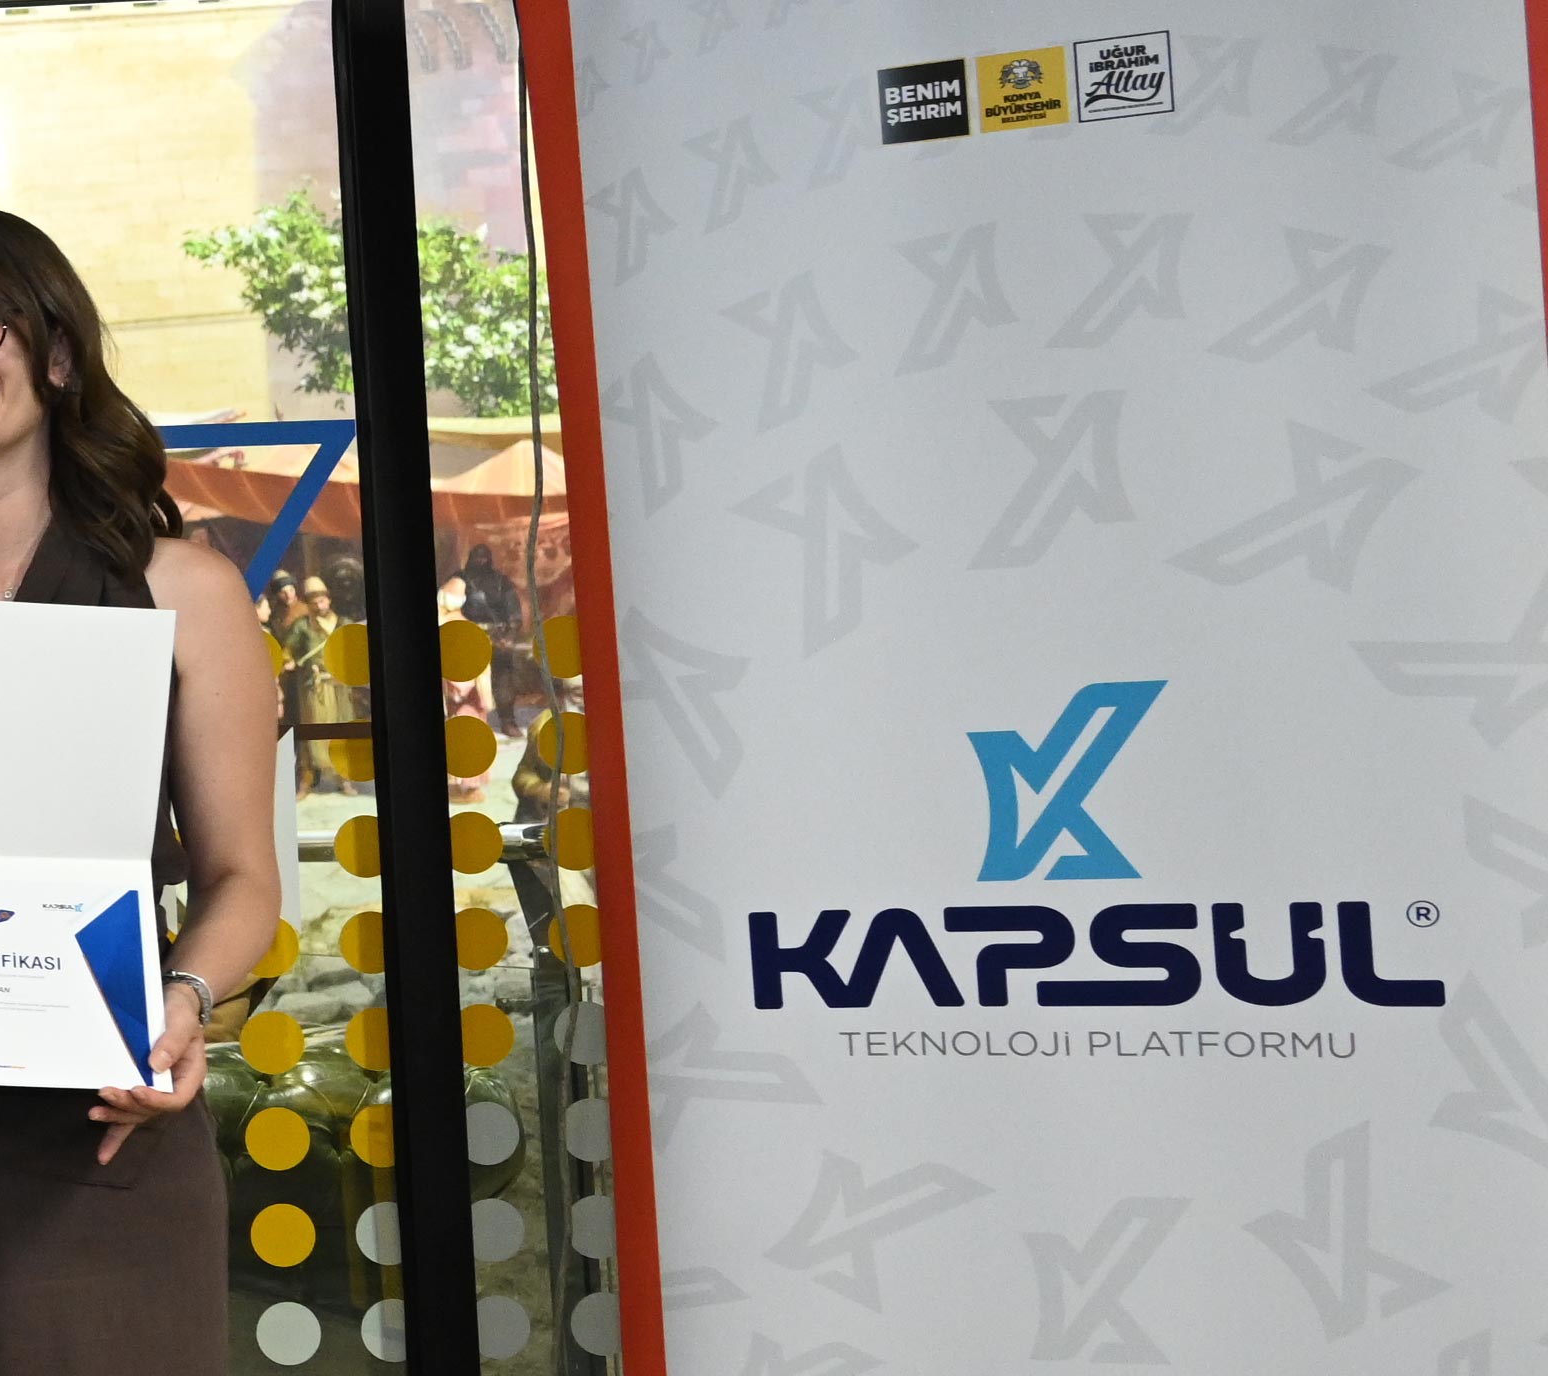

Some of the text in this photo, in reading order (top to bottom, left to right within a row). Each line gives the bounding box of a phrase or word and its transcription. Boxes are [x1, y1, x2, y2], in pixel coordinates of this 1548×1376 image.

[1099, 45, 1146, 60] UĞUR
[1003, 91, 1041, 103] KONYA
[1084, 70, 1165, 108] Altay
[985, 98, 1061, 118] BÜYÜKŞEHİR
[748, 900, 1446, 1011] KAPSUL
[1088, 1030, 1357, 1059] PLATFORMU
